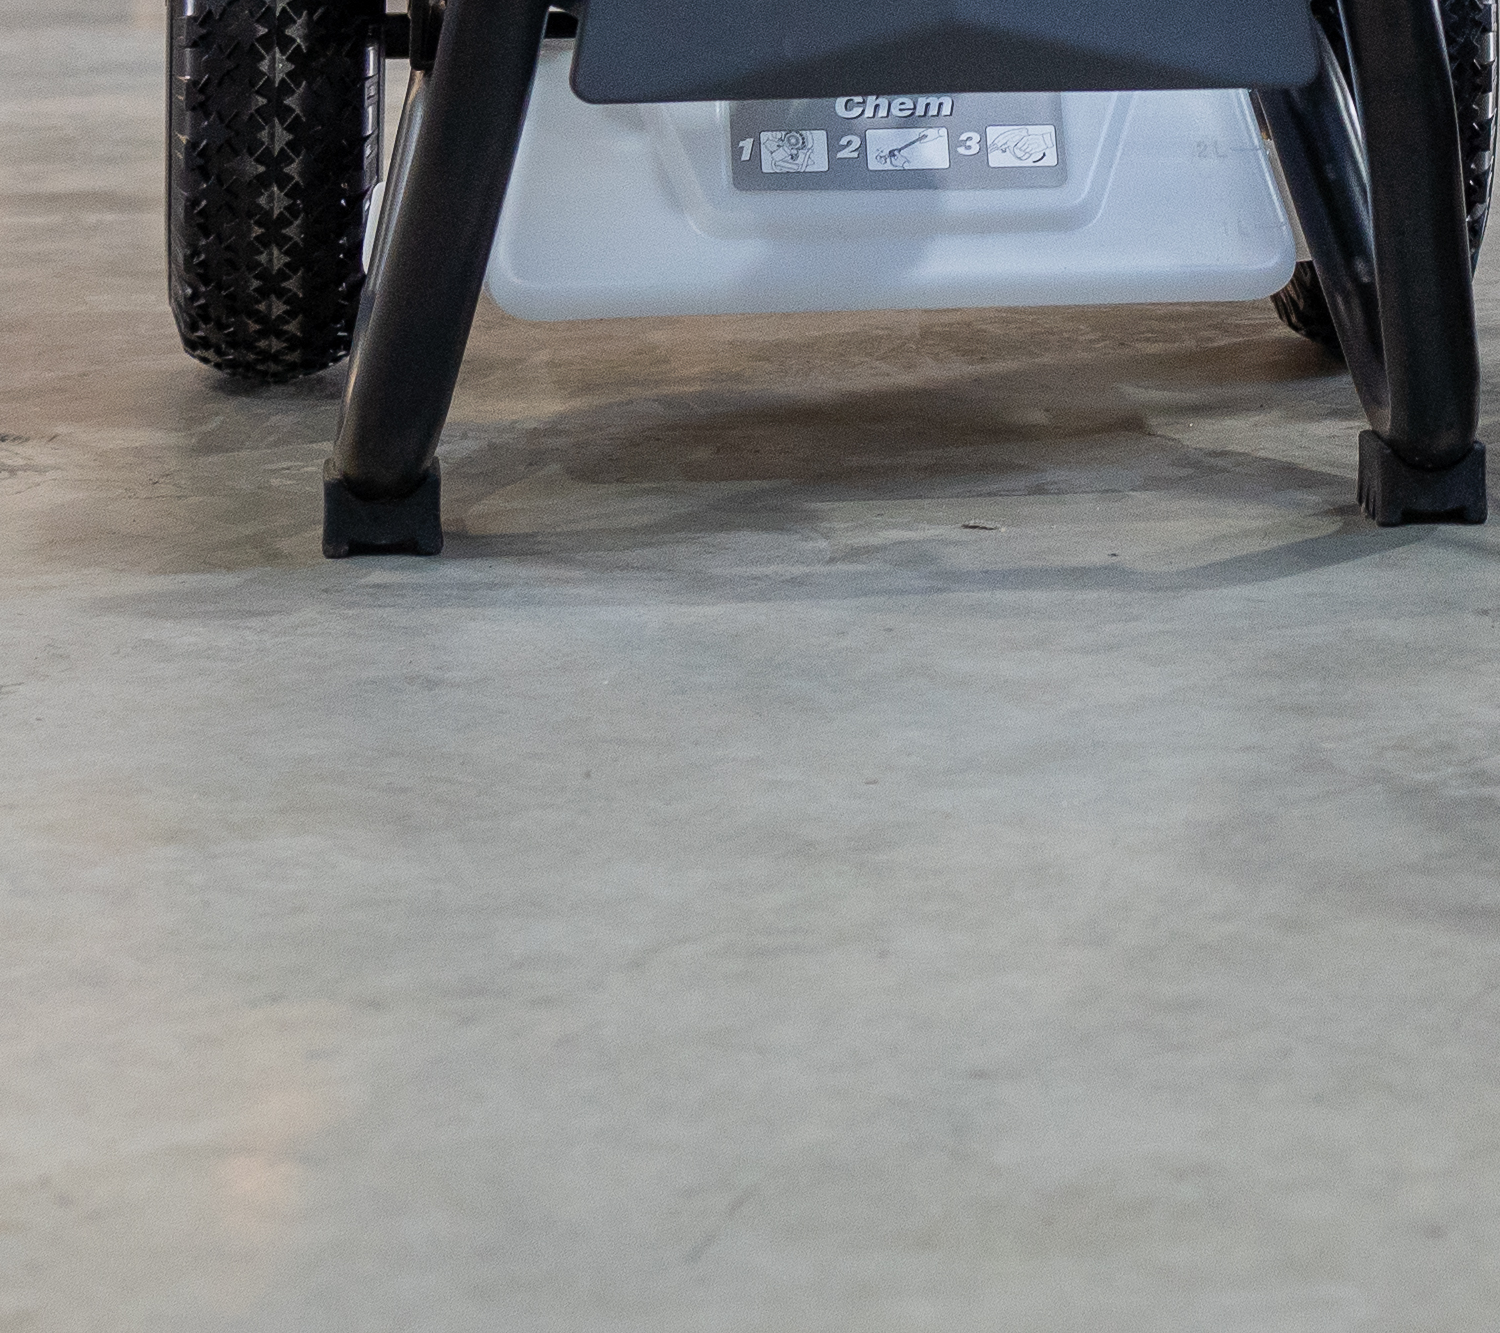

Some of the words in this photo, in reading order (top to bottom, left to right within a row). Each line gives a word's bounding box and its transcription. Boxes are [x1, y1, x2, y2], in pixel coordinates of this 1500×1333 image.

[834, 94, 955, 119] Chem
[737, 137, 755, 162] 1
[836, 134, 862, 159] 2
[956, 130, 982, 156] 3
